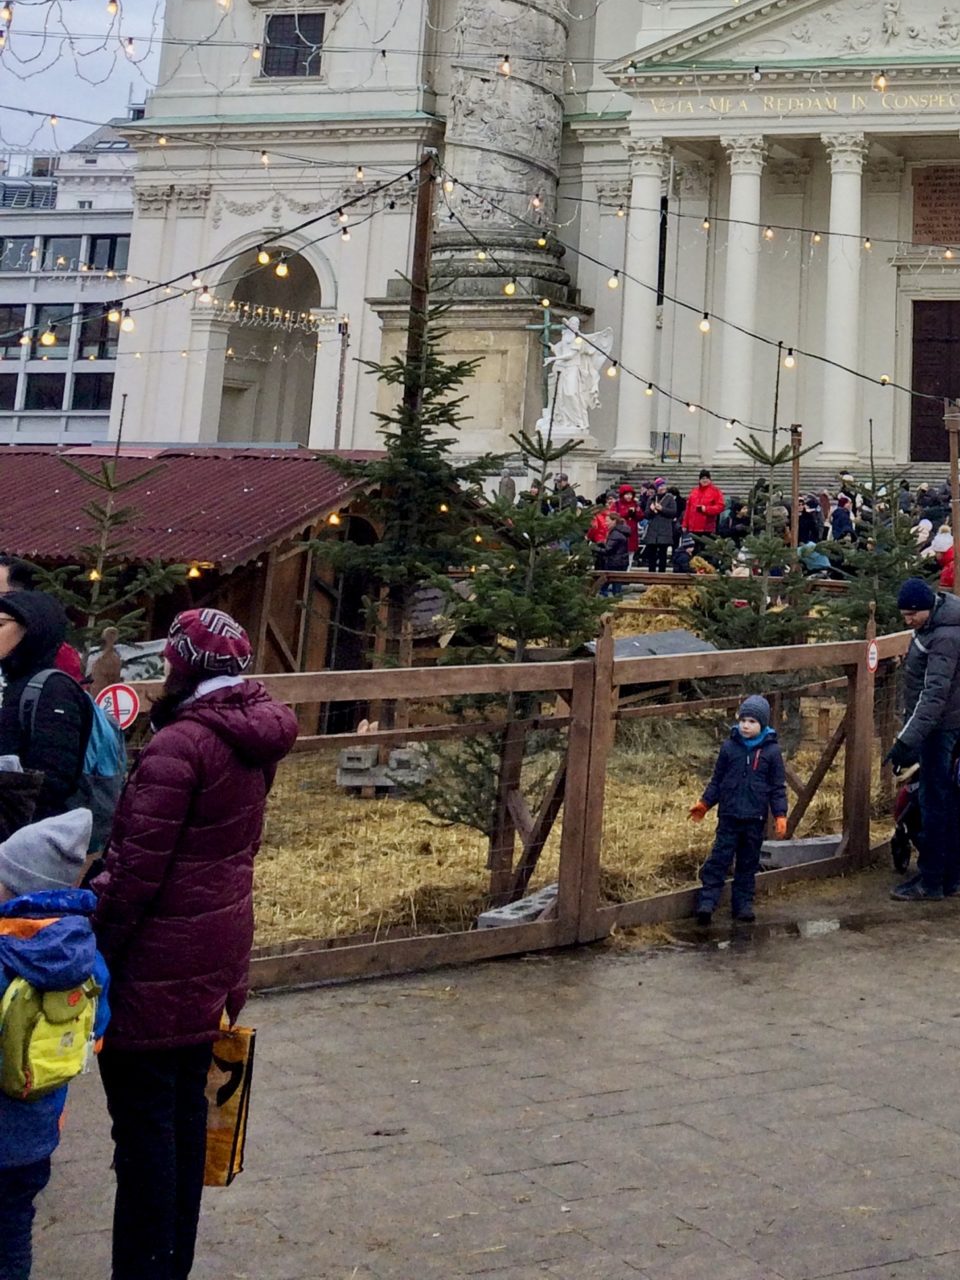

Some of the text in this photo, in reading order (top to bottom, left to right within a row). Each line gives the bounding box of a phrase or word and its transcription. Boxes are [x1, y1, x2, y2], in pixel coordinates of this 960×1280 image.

[651, 98, 694, 113] VOTA
[708, 96, 749, 113] MEA
[763, 95, 839, 112] REDDAM
[850, 93, 868, 110] IN
